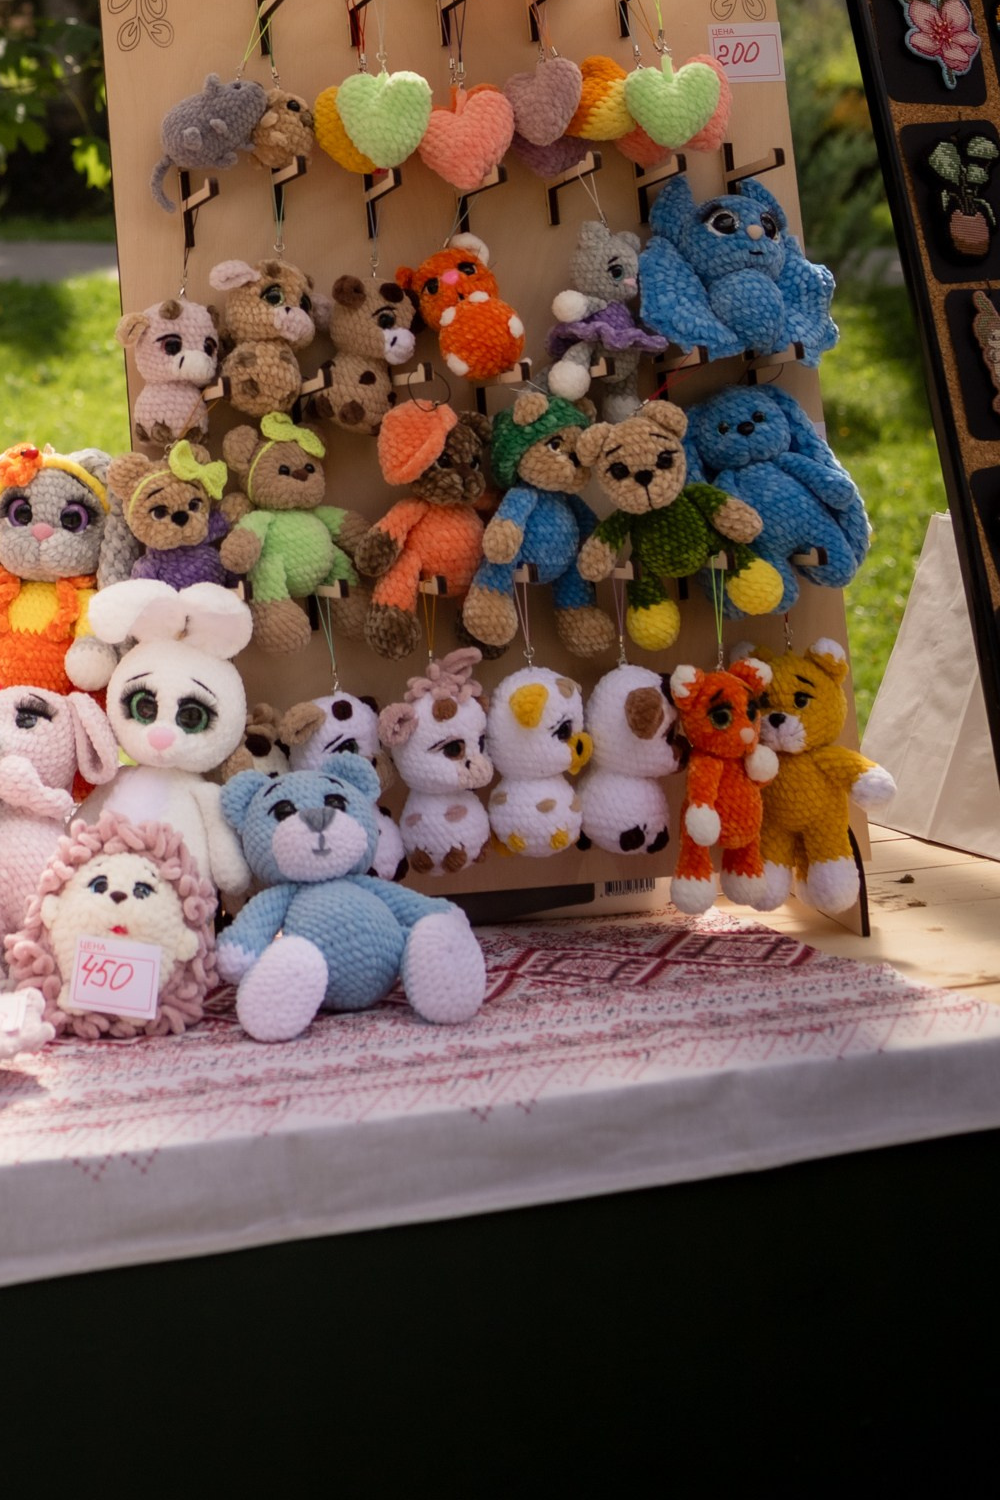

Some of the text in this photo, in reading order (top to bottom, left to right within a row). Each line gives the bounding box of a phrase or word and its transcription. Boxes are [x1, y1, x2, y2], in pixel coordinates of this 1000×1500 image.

[712, 28, 735, 36] ЦЕНА
[717, 41, 760, 66] 200
[80, 940, 106, 951] ЦЕНА
[81, 954, 134, 990] 450
